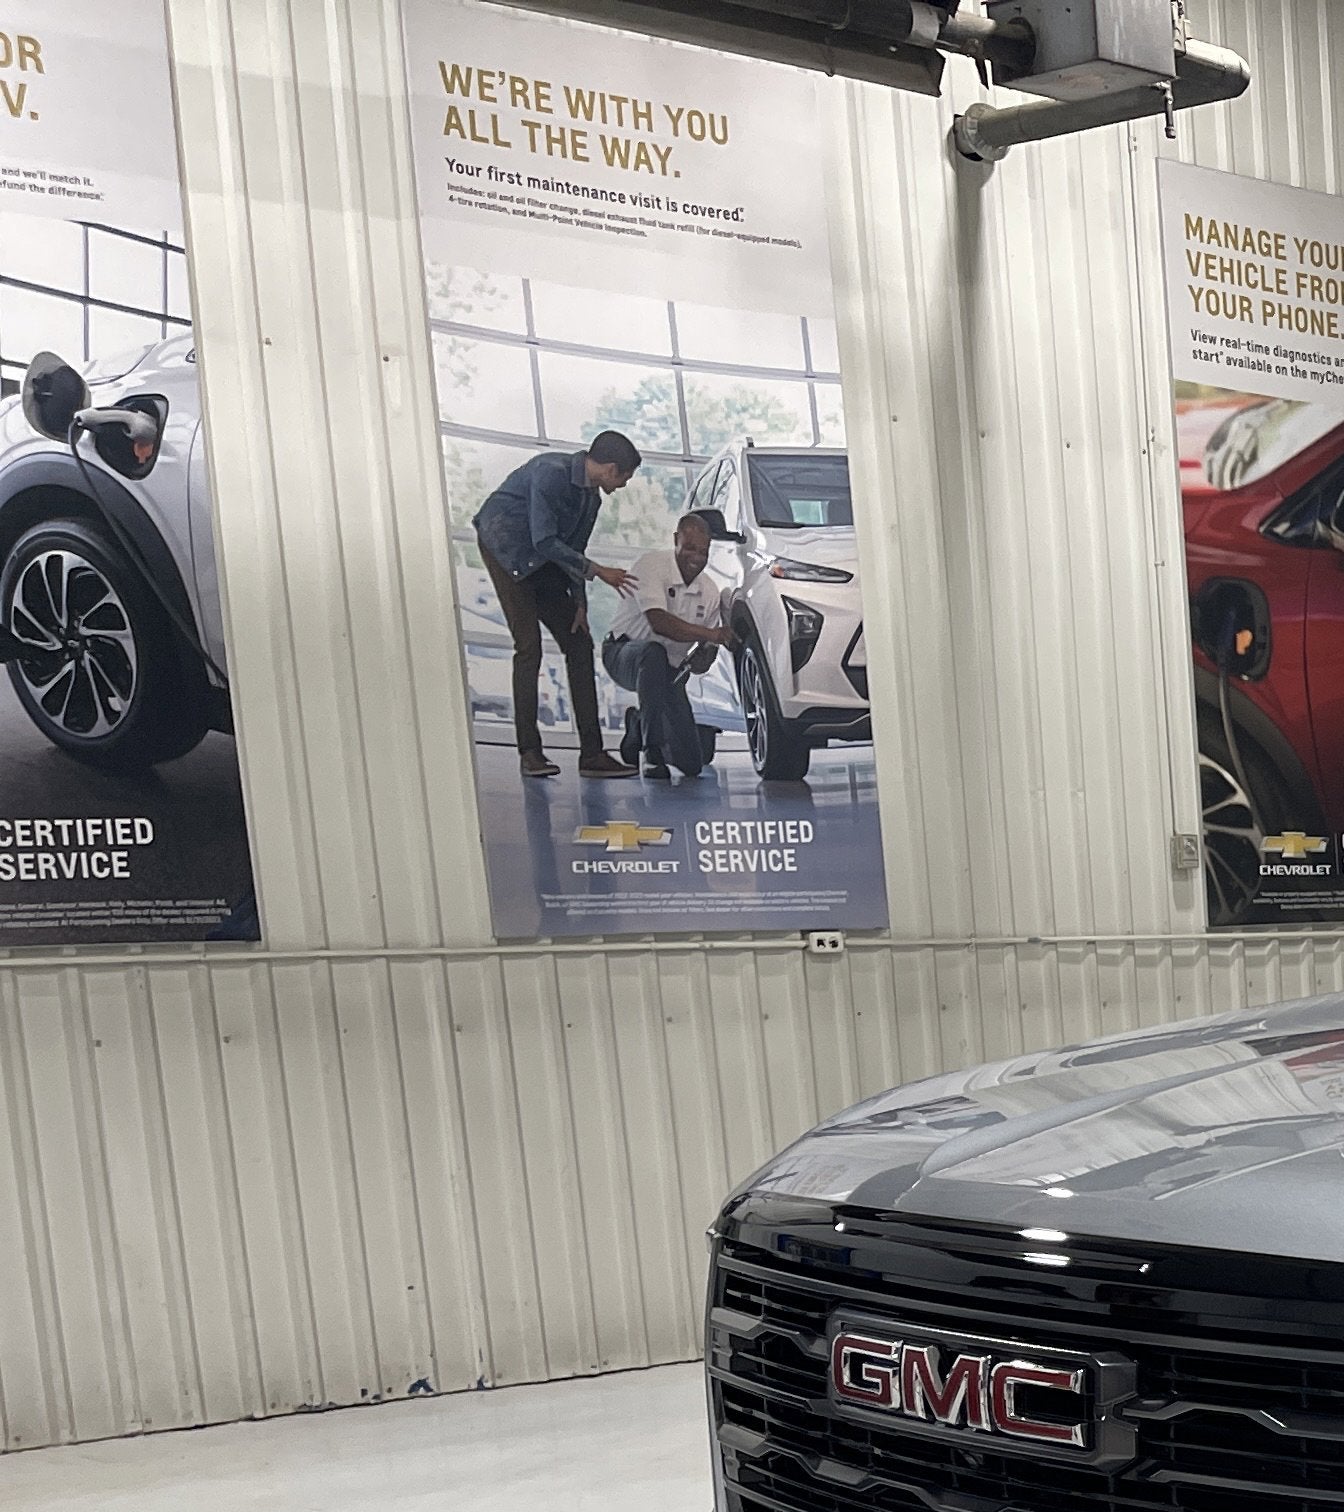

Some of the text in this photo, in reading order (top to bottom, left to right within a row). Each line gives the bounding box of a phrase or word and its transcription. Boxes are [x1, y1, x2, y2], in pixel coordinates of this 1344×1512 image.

[438, 61, 729, 145] WE'RE WITH YOU
[443, 105, 680, 178] ALL THE WAY.
[49, 174, 81, 185] match
[445, 157, 482, 178] Your
[487, 165, 523, 186] first
[527, 177, 626, 204] maintenance
[630, 192, 661, 210] visit
[666, 197, 678, 212] is
[1184, 213, 1288, 262] MANAGE
[1186, 249, 1289, 296] VEHICLE
[1188, 284, 1254, 324] YOUR
[1190, 328, 1217, 346] View
[1220, 335, 1270, 356] real-time
[1273, 345, 1332, 367] diagnostics
[1225, 355, 1273, 375] available
[1275, 365, 1288, 377] on
[1291, 366, 1308, 380] the
[0, 818, 154, 847] CERTIFIED
[695, 820, 814, 845] CERTIFIED
[0, 851, 130, 881] SERVICE
[571, 860, 680, 874] CHEVROLET
[698, 848, 798, 873] SERVICE
[1259, 864, 1332, 876] CHEVROLET
[832, 1333, 1085, 1447] GMC
